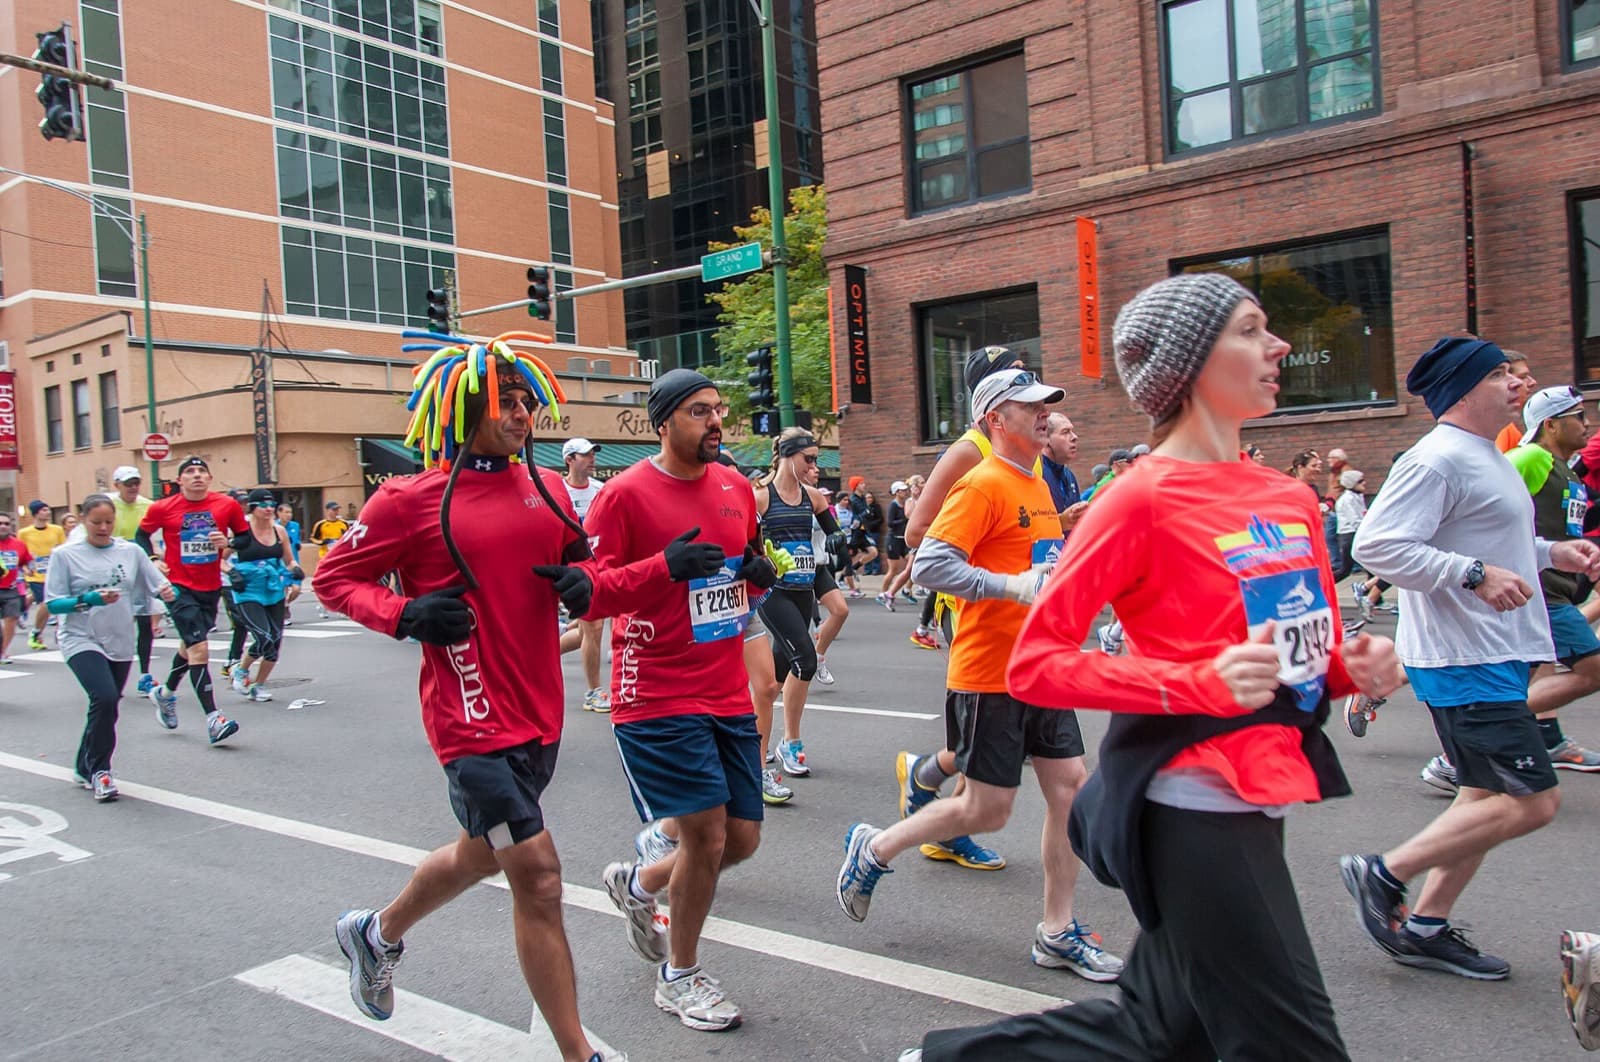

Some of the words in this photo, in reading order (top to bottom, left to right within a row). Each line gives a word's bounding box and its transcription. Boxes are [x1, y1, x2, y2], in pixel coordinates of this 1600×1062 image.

[716, 251, 743, 267] GRAND
[1281, 350, 1331, 368] IMUS
[695, 592, 704, 616] F
[707, 584, 745, 614] 22667
